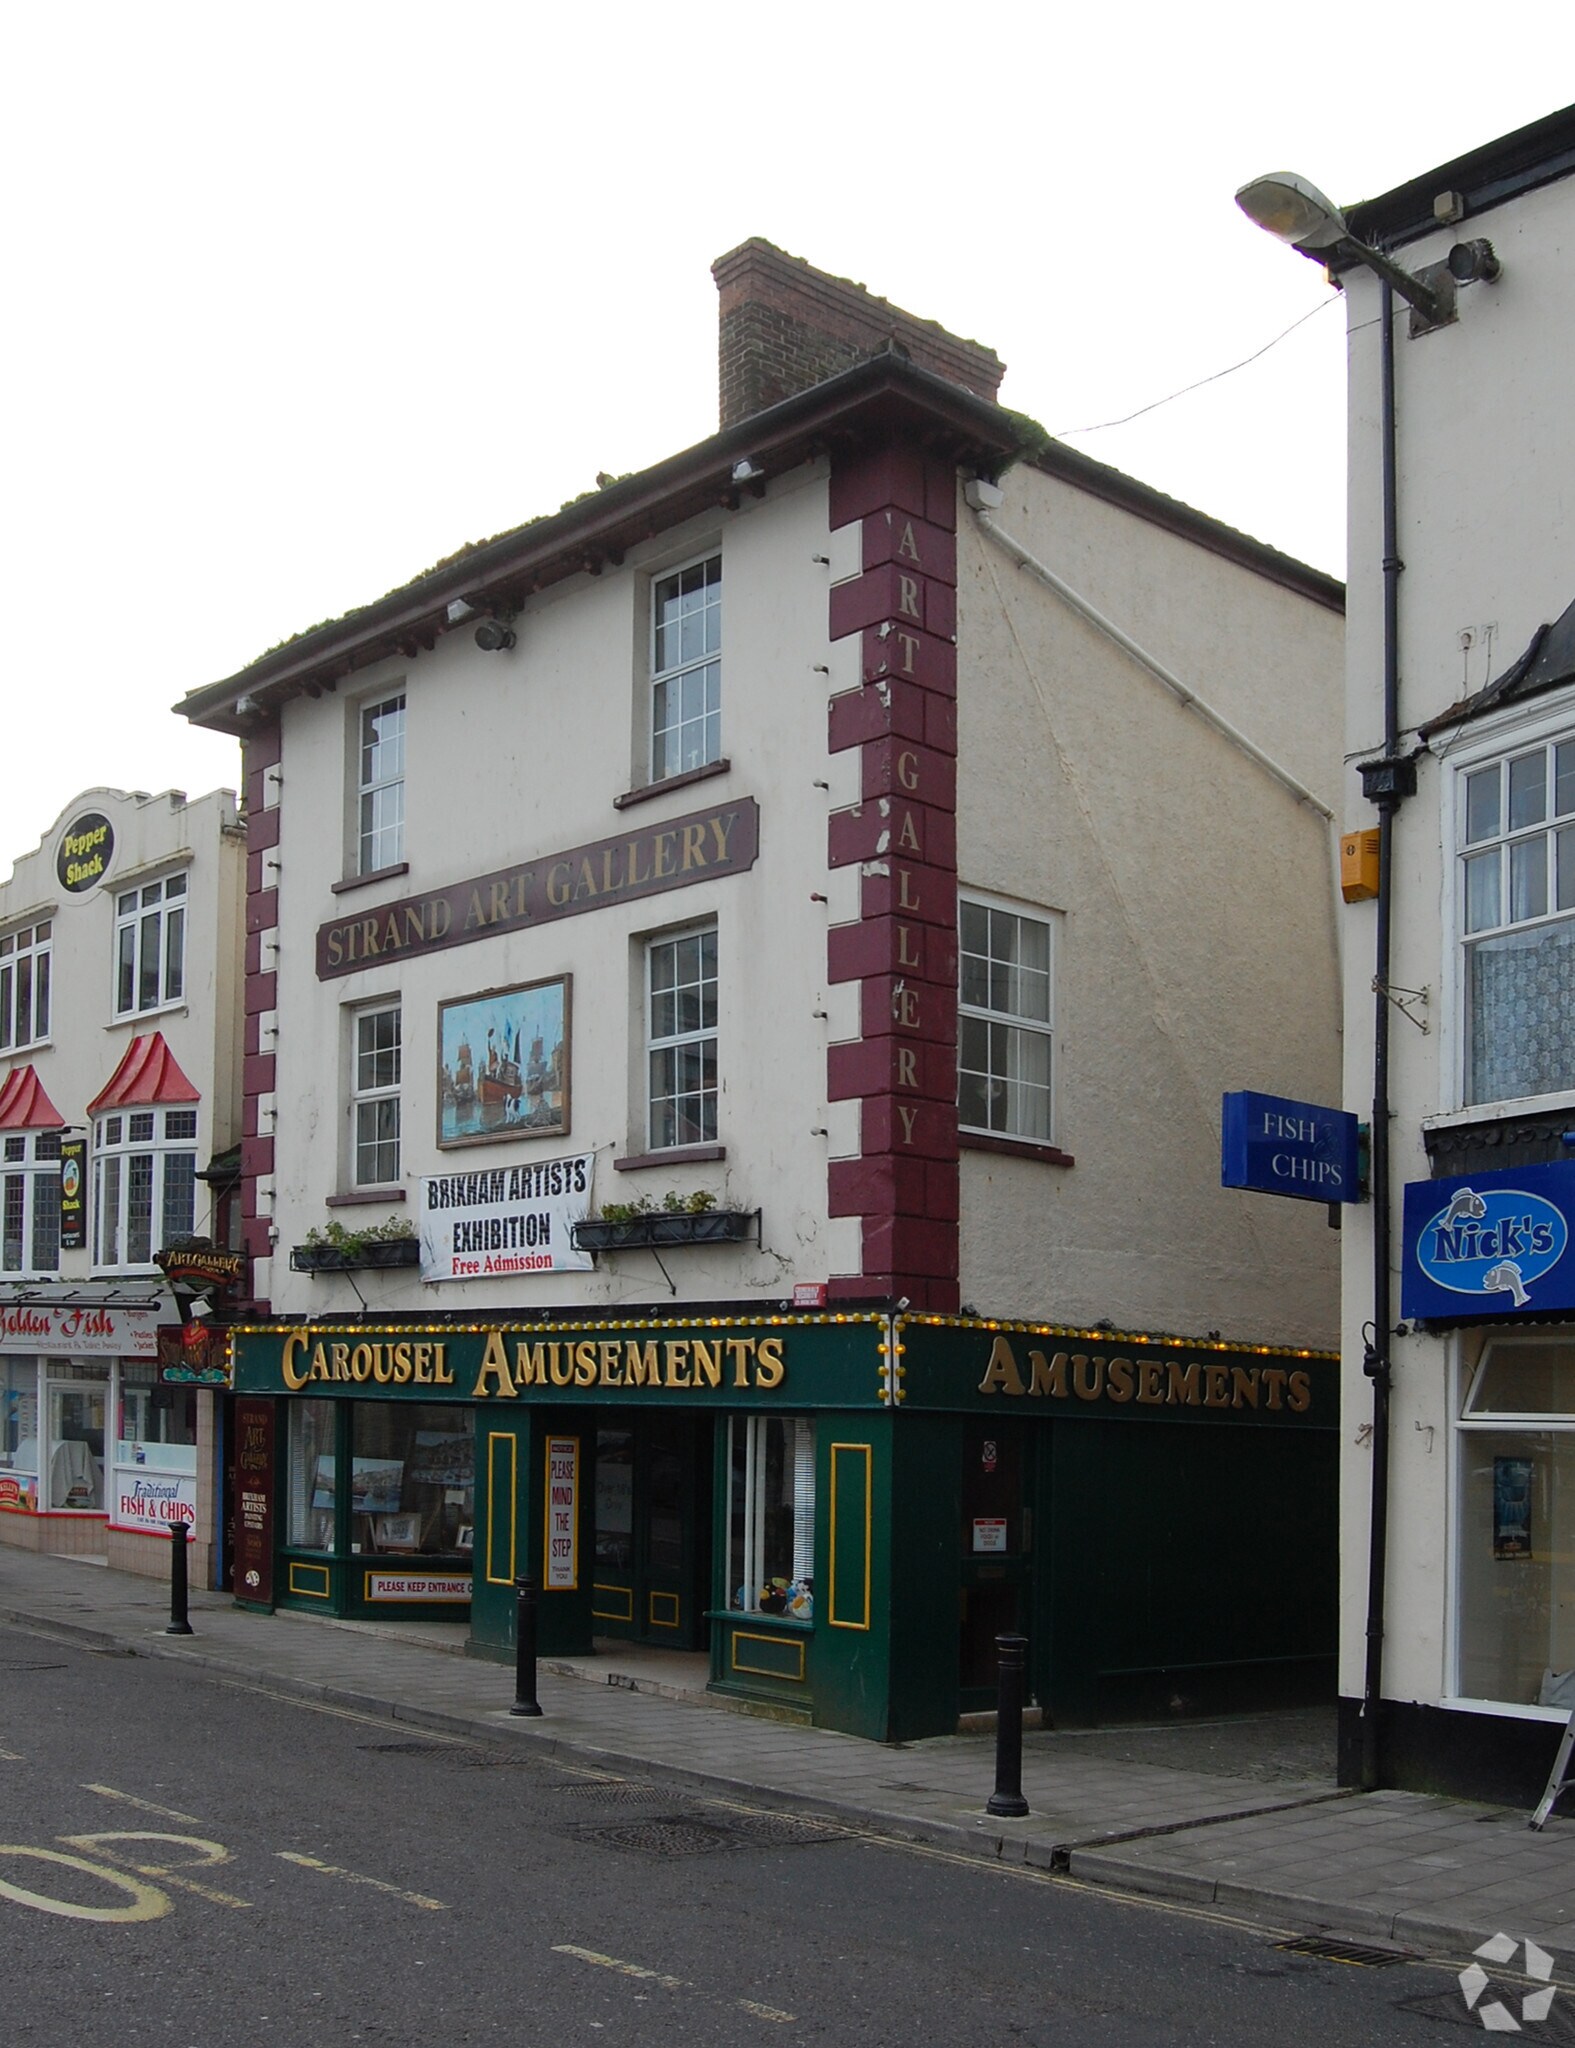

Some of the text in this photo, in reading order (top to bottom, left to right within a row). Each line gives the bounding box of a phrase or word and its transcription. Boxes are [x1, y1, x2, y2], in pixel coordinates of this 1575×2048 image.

[64, 823, 107, 857] Pepper
[897, 521, 920, 1145] ART GALLERY
[66, 854, 104, 885] Shack
[327, 812, 739, 967] STRAND ART GALLERY
[1263, 1112, 1317, 1143] FISH
[428, 1158, 587, 1211] BRIXHAM ARTISTS
[1271, 1153, 1343, 1186] CHIPS
[453, 1212, 551, 1254] EXHIBITION
[167, 1250, 192, 1267] ART
[452, 1251, 553, 1275] Free Admission
[60, 1306, 115, 1337] Fish
[281, 1330, 785, 1398] CAROUSEL AMUSEMENTS
[977, 1335, 1311, 1412] AMUSEMENTS
[551, 1460, 574, 1480] PLEASE
[133, 1480, 182, 1501] Traditional
[552, 1486, 573, 1506] MIND
[121, 1496, 145, 1516] FISH
[149, 1499, 157, 1518] &
[160, 1500, 195, 1524] CHIPS
[241, 1502, 267, 1514] ARTISTS
[554, 1512, 570, 1532] THE
[552, 1538, 572, 1558] STEP
[377, 1581, 405, 1592] PLEASE
[407, 1581, 427, 1593] KEEP
[428, 1582, 465, 1594] ENTRANCE
